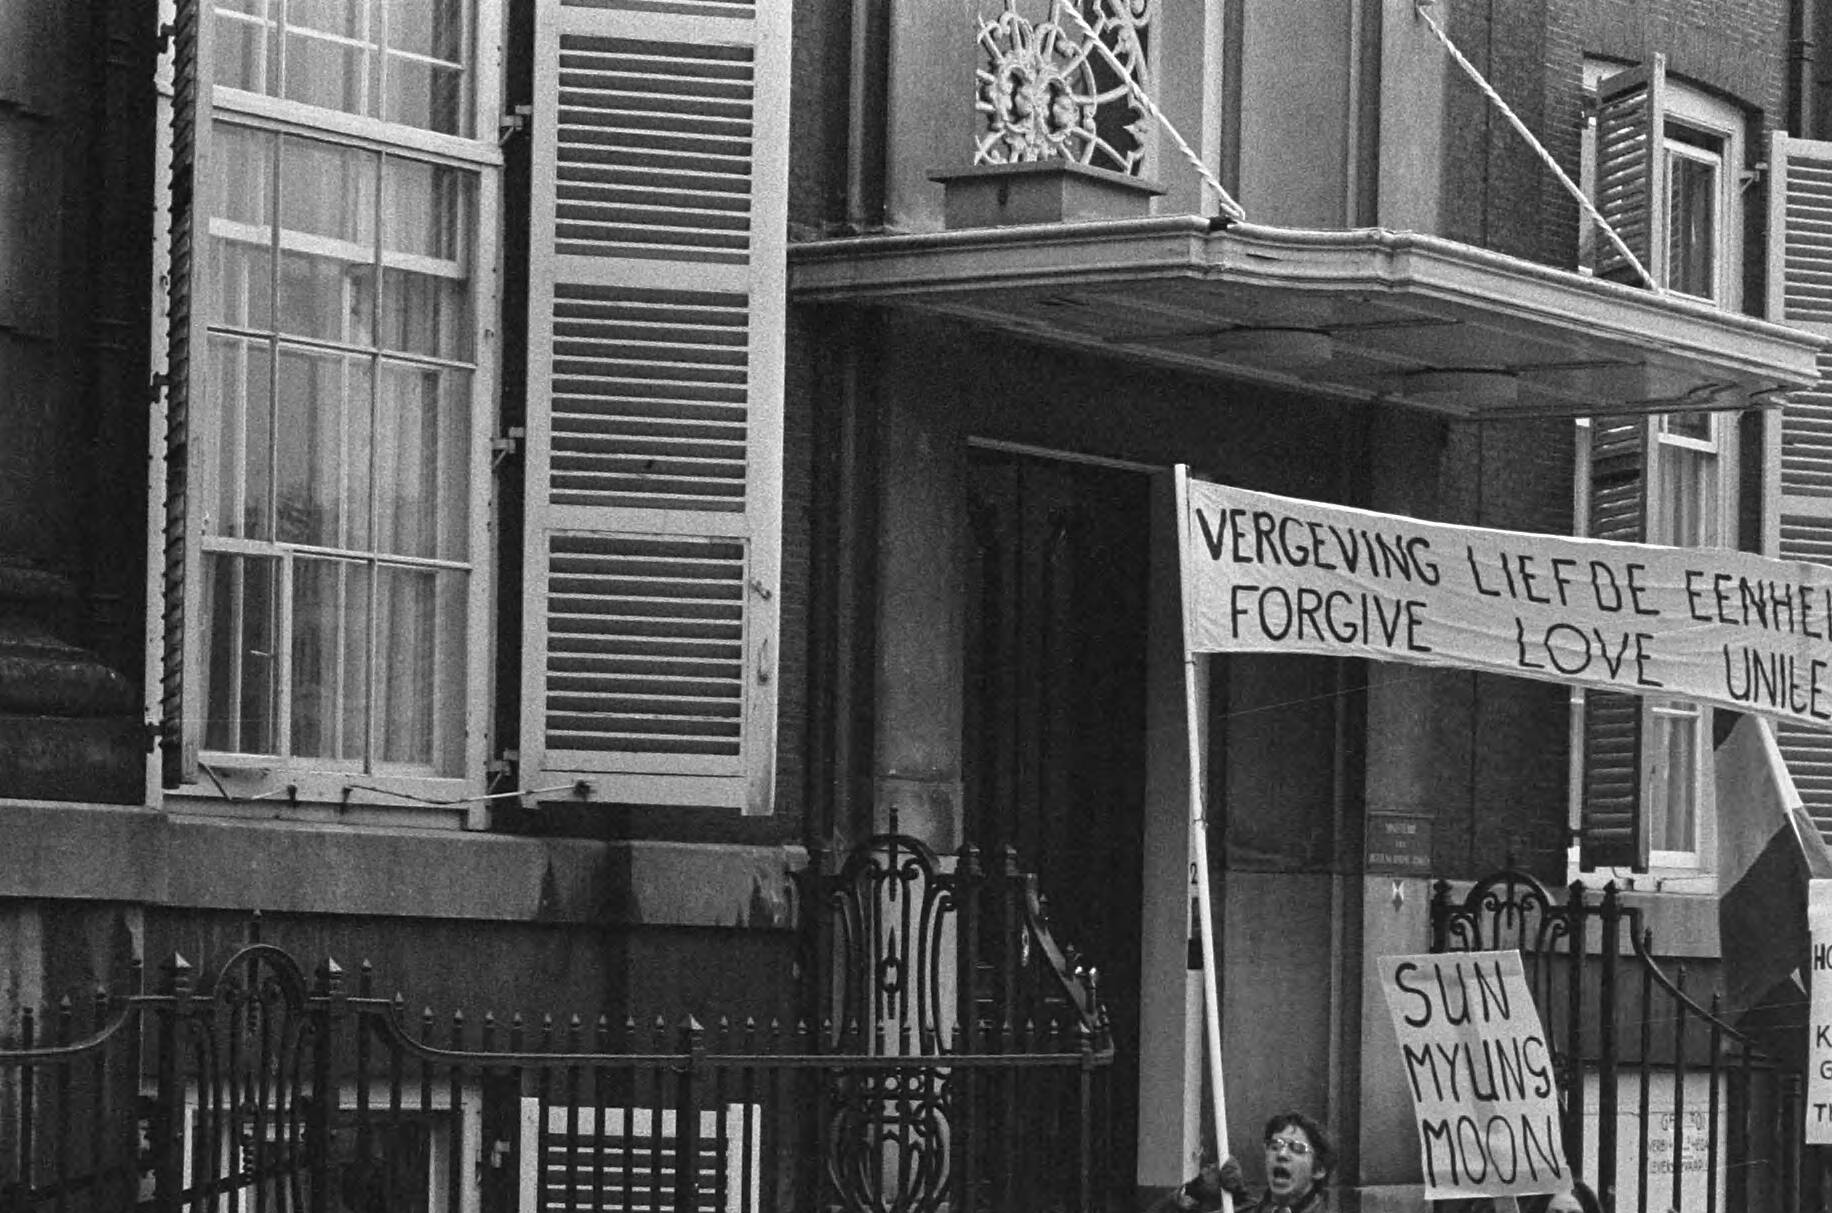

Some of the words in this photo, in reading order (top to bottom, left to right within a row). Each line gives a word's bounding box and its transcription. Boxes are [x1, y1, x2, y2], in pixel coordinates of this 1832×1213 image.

[1197, 507, 1441, 586] VERGEVING
[1467, 545, 1661, 616] LIEFDE
[1231, 585, 1432, 652] FORGIVE
[1514, 617, 1664, 688] LOVE
[1394, 959, 1511, 1028] SUN
[1403, 1036, 1552, 1103] MYUNG
[1422, 1114, 1562, 1188] MOON
